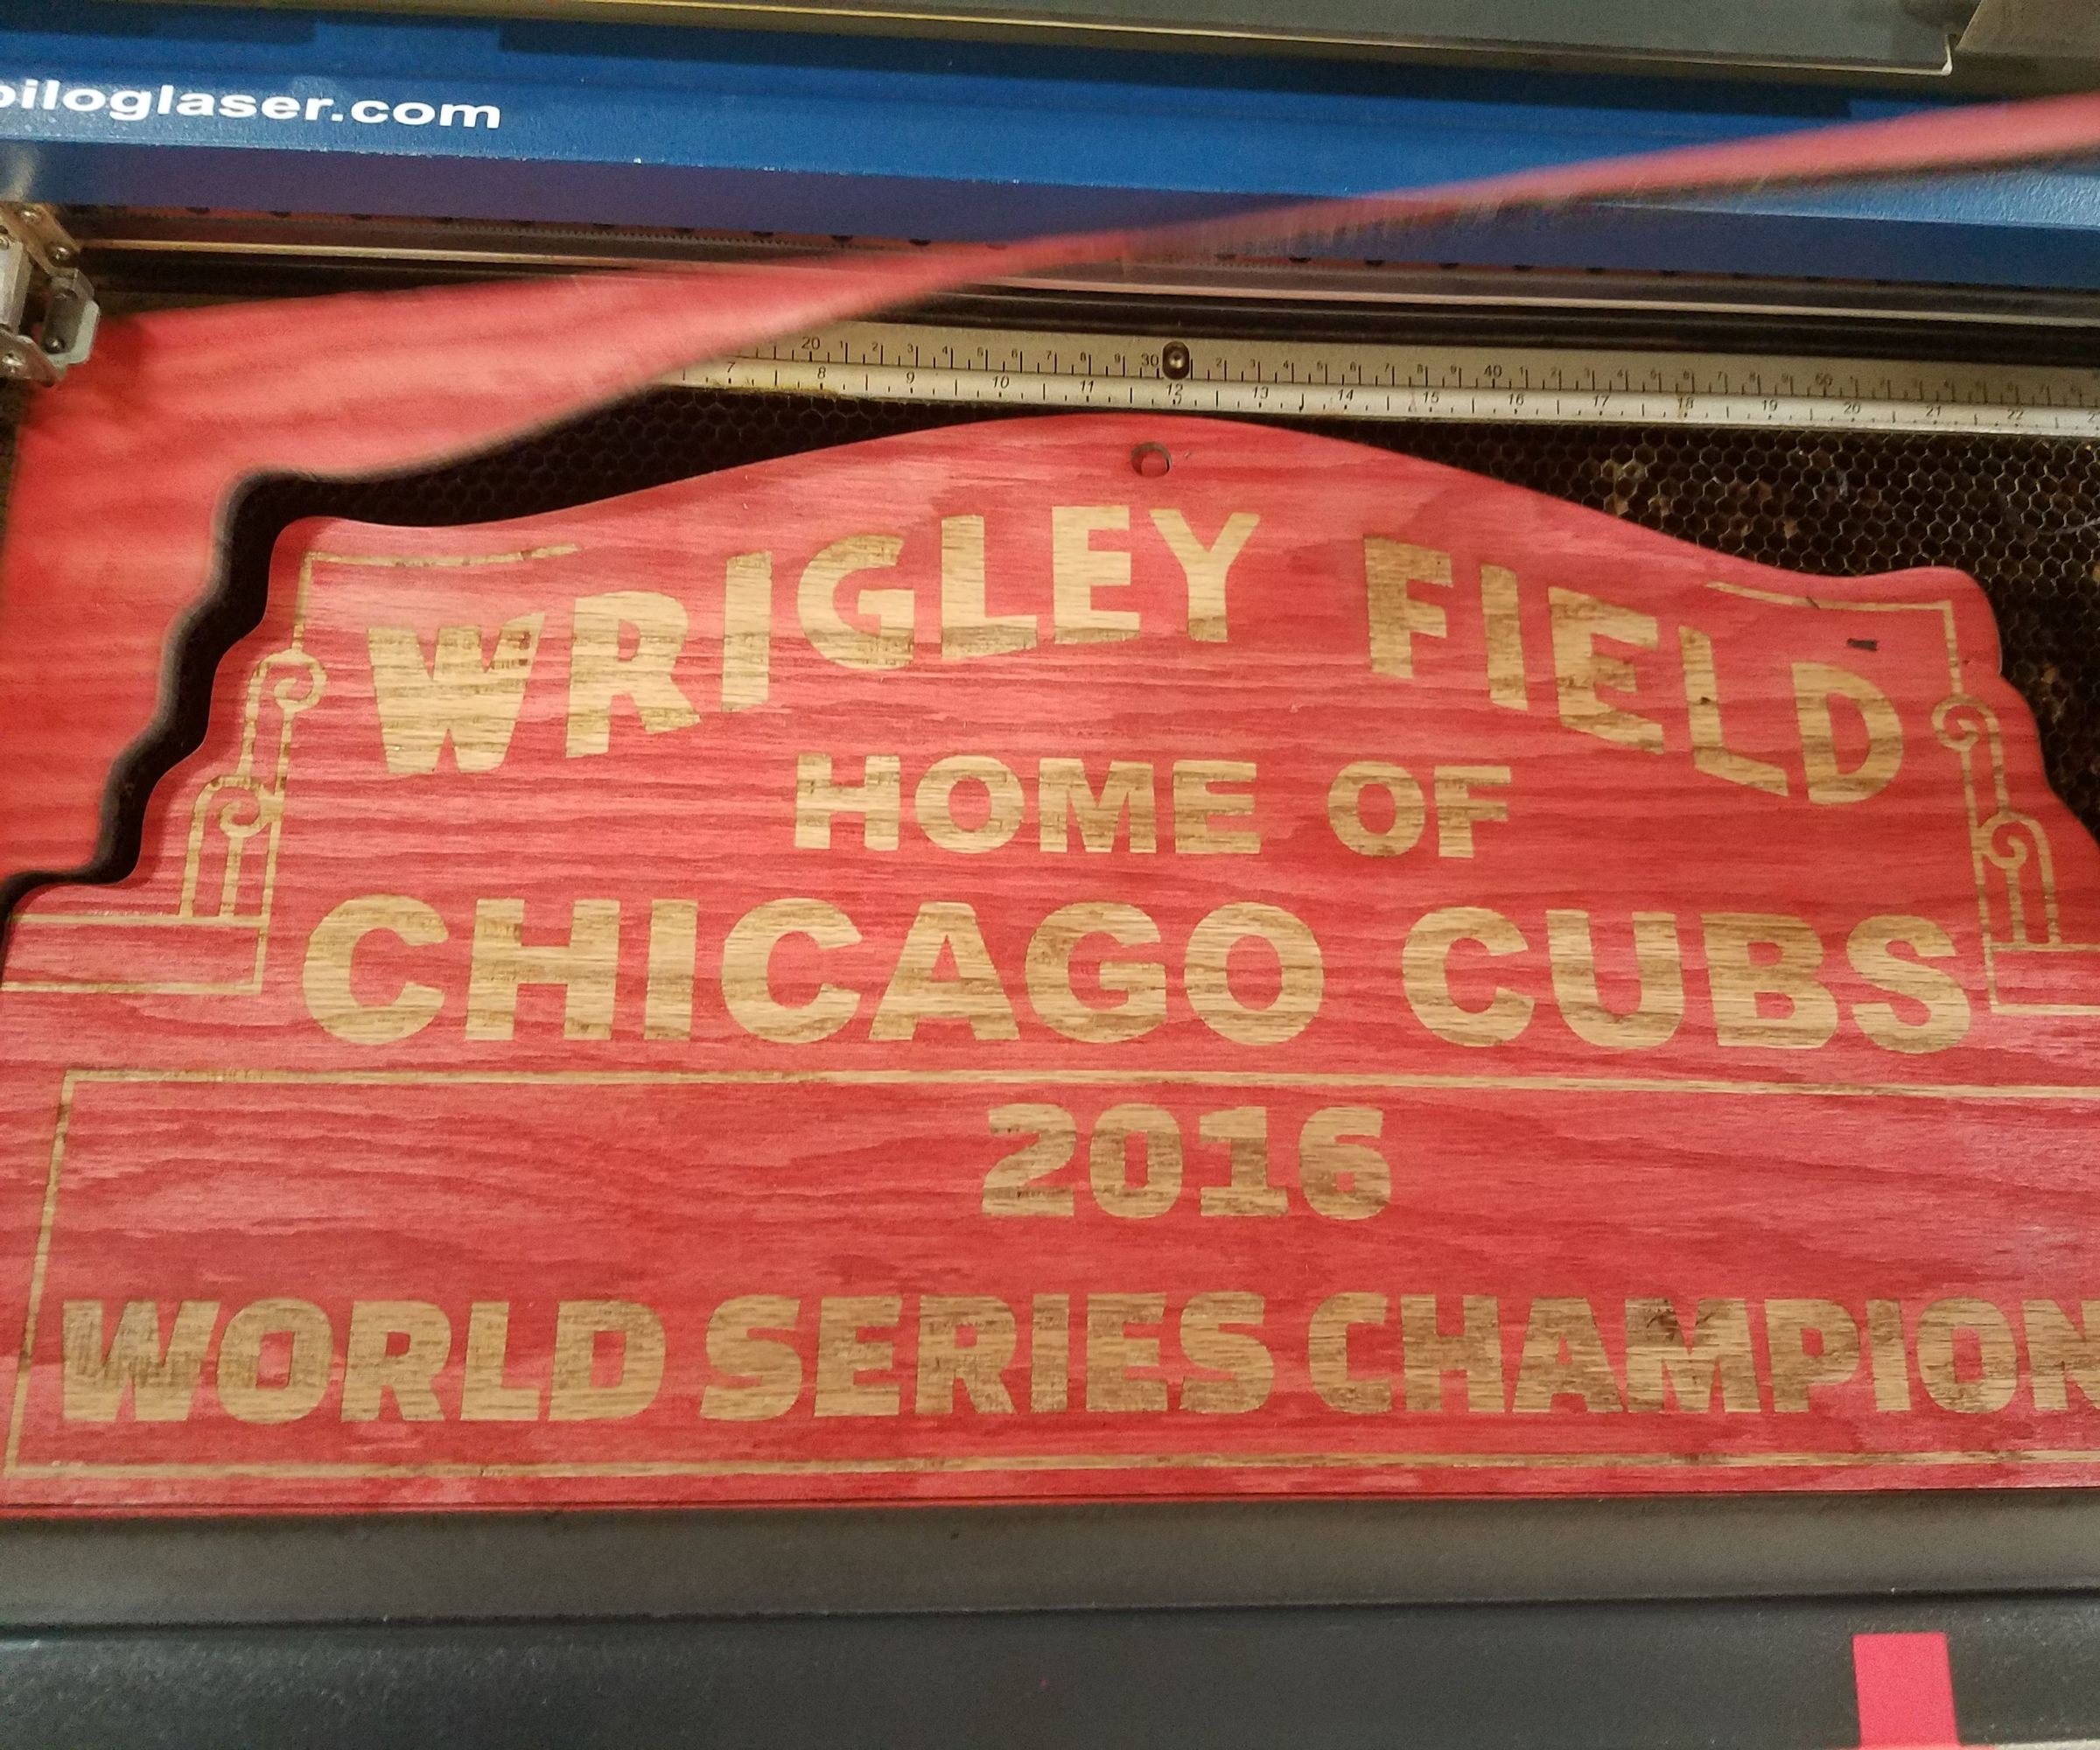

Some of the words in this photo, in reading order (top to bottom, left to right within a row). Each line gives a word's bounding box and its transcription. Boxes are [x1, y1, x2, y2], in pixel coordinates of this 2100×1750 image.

[726, 361, 736, 373] 7
[817, 367, 826, 379] 8
[906, 371, 915, 383] 9
[992, 375, 1010, 389] 10
[1081, 380, 1095, 393] 11
[1166, 383, 1183, 397] 12
[1253, 386, 1269, 400] 13
[1338, 388, 1354, 402] 14
[1424, 391, 1439, 403] 15
[1508, 393, 1525, 405] 16
[1594, 395, 1610, 408] 17
[1762, 399, 1778, 412] 19
[1843, 402, 1860, 415] 20
[1926, 405, 1942, 417] 21
[2006, 409, 2024, 421] 22
[802, 337, 821, 350] 20
[872, 342, 878, 352] 2
[1141, 353, 1160, 368] 30
[1484, 364, 1502, 377] 40
[368, 505, 1260, 774] WRIGLEY
[1363, 534, 1905, 805] FIELD
[794, 752, 1262, 855] HOME
[1327, 760, 1512, 858] OF
[303, 894, 1325, 1046] CHICAGO
[1401, 906, 1971, 1054] CUBS
[982, 1102, 1392, 1221] 2016
[62, 1298, 667, 1424] WORLD
[700, 1291, 1276, 1423] SERIES
[1307, 1292, 2100, 1415] CHAMPION
